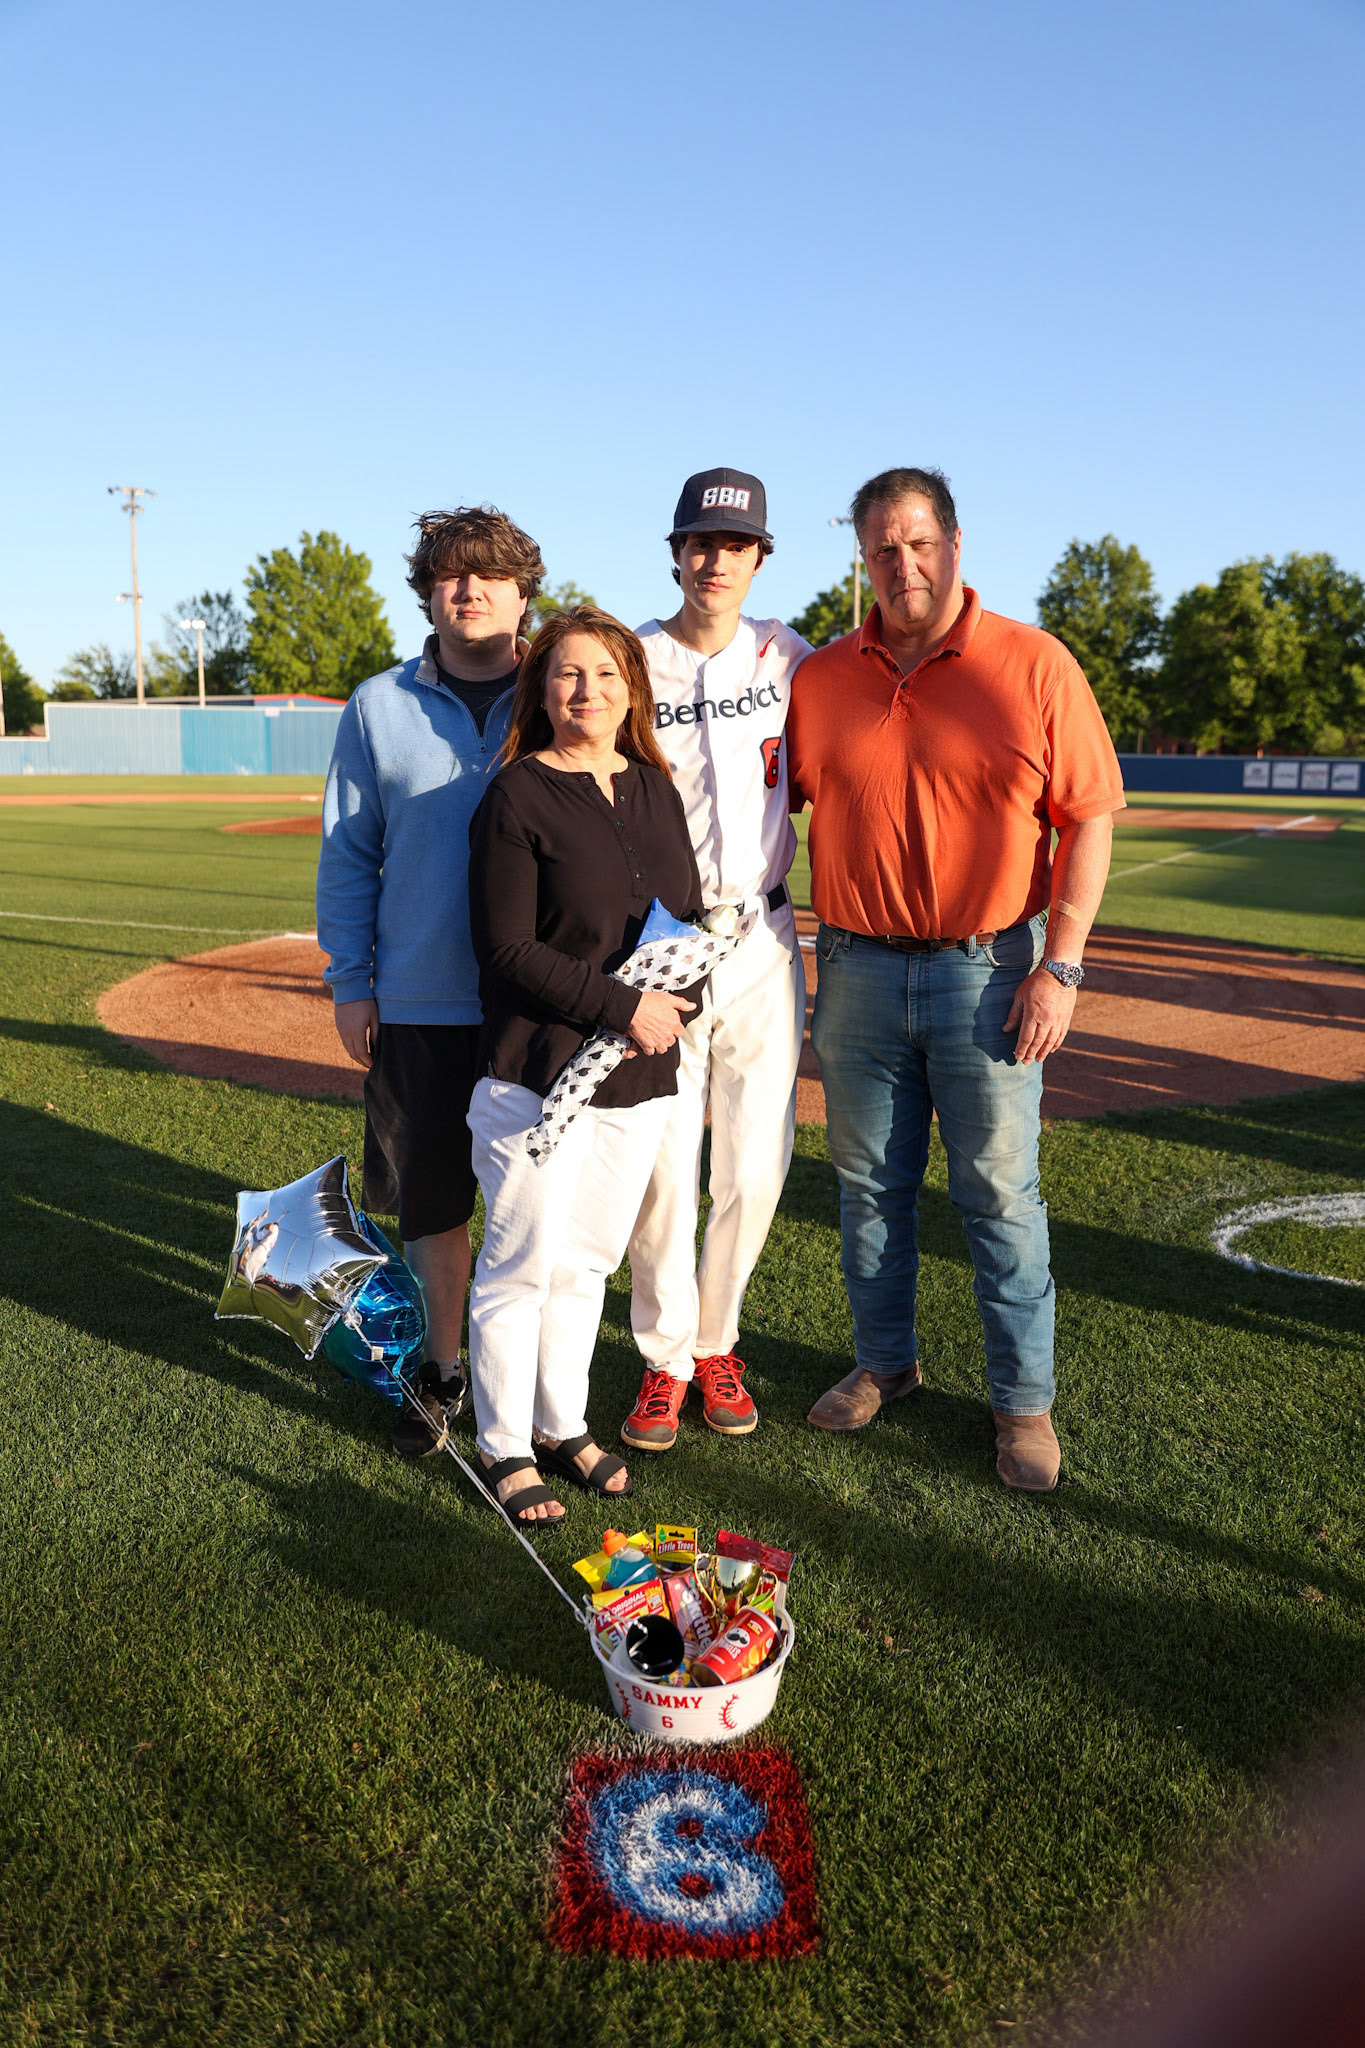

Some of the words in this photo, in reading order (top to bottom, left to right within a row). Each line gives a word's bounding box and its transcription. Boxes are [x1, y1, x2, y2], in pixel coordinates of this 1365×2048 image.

[701, 485, 751, 512] SBA
[655, 681, 782, 729] Benedict
[611, 1591, 646, 1615] ORIGINAL
[631, 1685, 703, 1709] SAMMY
[661, 1716, 674, 1729] 6
[600, 1775, 776, 1932] 6
